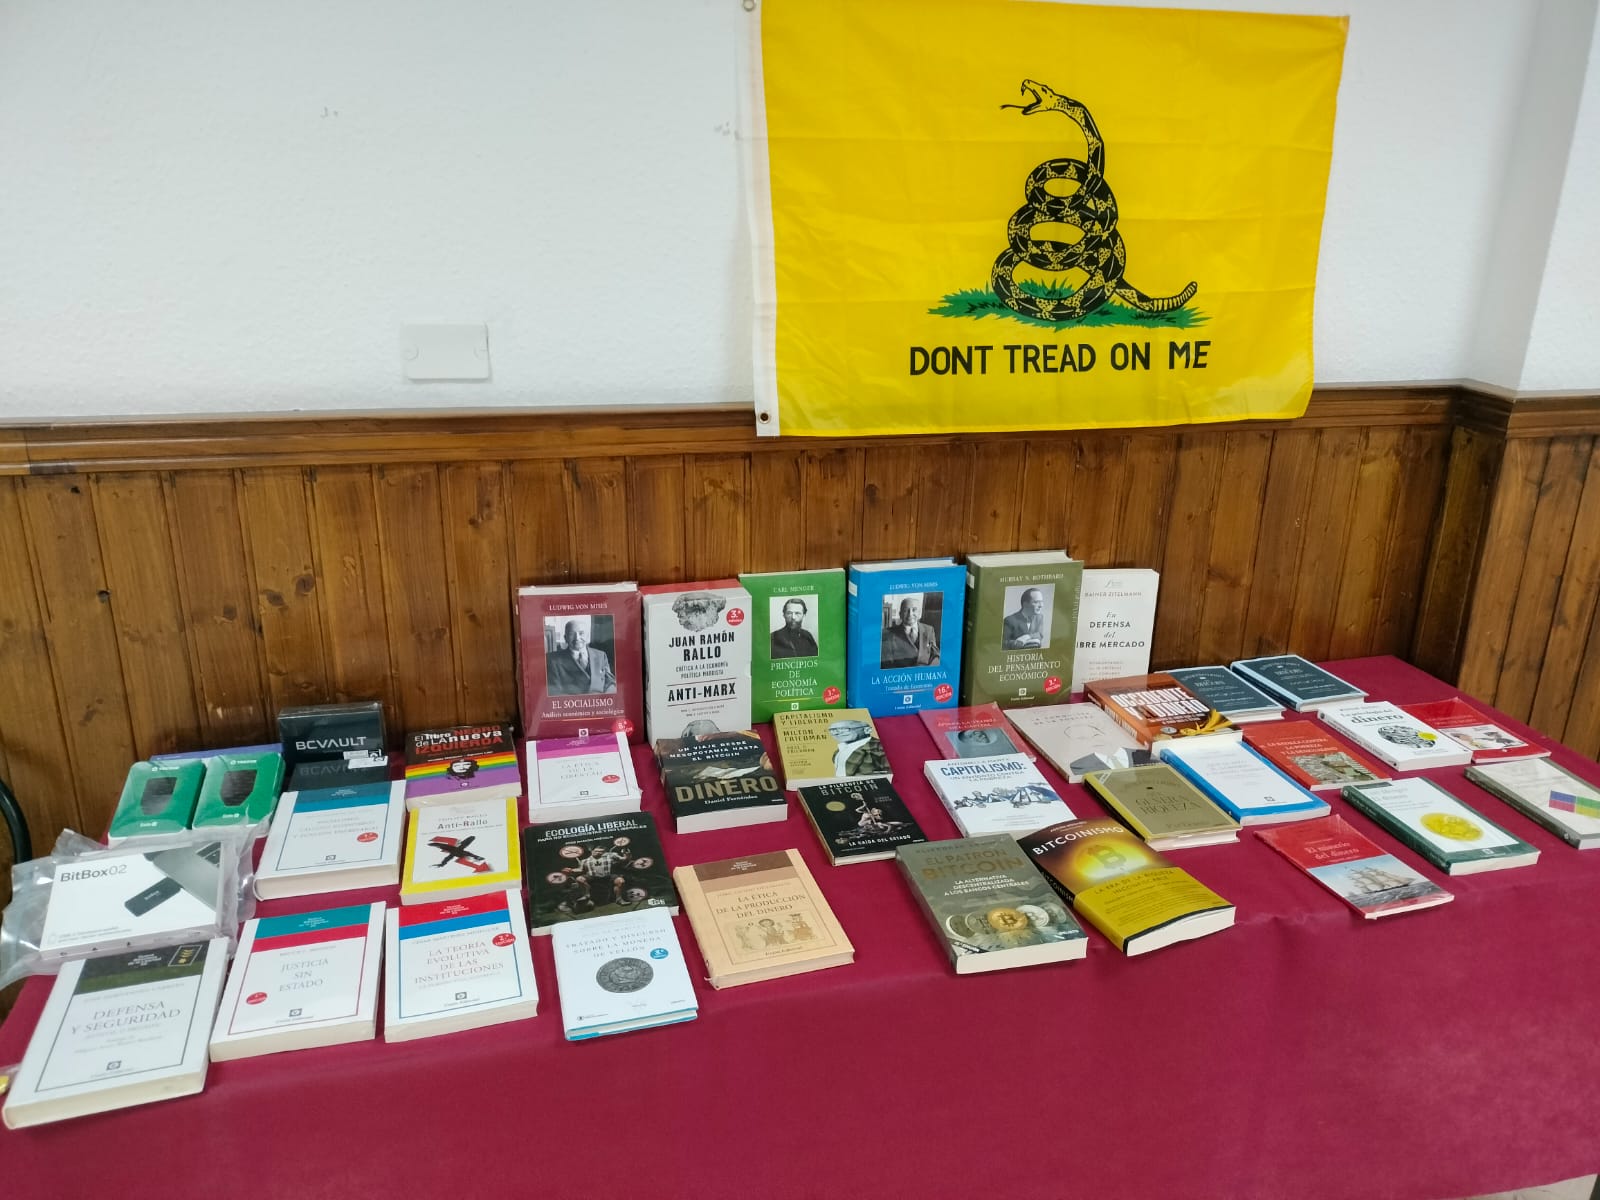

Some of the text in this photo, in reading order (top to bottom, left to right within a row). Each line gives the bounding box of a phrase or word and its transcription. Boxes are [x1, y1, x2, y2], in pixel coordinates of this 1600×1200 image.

[909, 340, 1211, 376] DONT TREAD ON ME
[668, 630, 734, 648] JUAN RAMÓN
[683, 646, 721, 662] RALLO
[770, 660, 818, 670] PRINCIPIOS
[988, 660, 1061, 674] DEL PENSAMIENTO
[789, 670, 800, 678] DE
[872, 672, 947, 684] LA ACCIÓN HUMANA
[1000, 670, 1048, 682] ECONÓMICO
[772, 677, 818, 688] ECONOMÍA
[668, 682, 736, 702] ANTI-MARX
[776, 688, 814, 698] POLÍTICA
[552, 698, 614, 709] EL SOCIALISMO
[780, 712, 834, 720] CAPITALISMO
[1351, 714, 1404, 724] dinero
[296, 736, 367, 750] BCVAULT
[416, 736, 504, 754] IZQUIERDA
[940, 762, 1028, 776] CAPITALISMO:
[674, 776, 778, 803] DINERO
[820, 784, 879, 796] BITCOIN
[438, 819, 488, 830] Anti-Rallo
[545, 819, 638, 838] ECOLOGÍA LIBERAL
[1032, 826, 1124, 856] BITCOINISMO
[922, 857, 1024, 879] BITCOIN
[926, 856, 944, 866] EL
[60, 864, 128, 882] BitBox02
[744, 894, 806, 910] PRODUCCIÓN
[736, 904, 793, 919] DEL DINERO
[447, 941, 486, 953] TEORÍA
[427, 948, 490, 965] EVOLUTIVA
[459, 959, 478, 968] LAS
[280, 958, 329, 973] JUSTICIA
[294, 970, 312, 979] SIN
[415, 962, 504, 984] INSTITUCIONES
[279, 978, 324, 992] ESTADO
[93, 1000, 165, 1020] DEFENSA
[82, 1008, 182, 1032] SEGURIDAD
